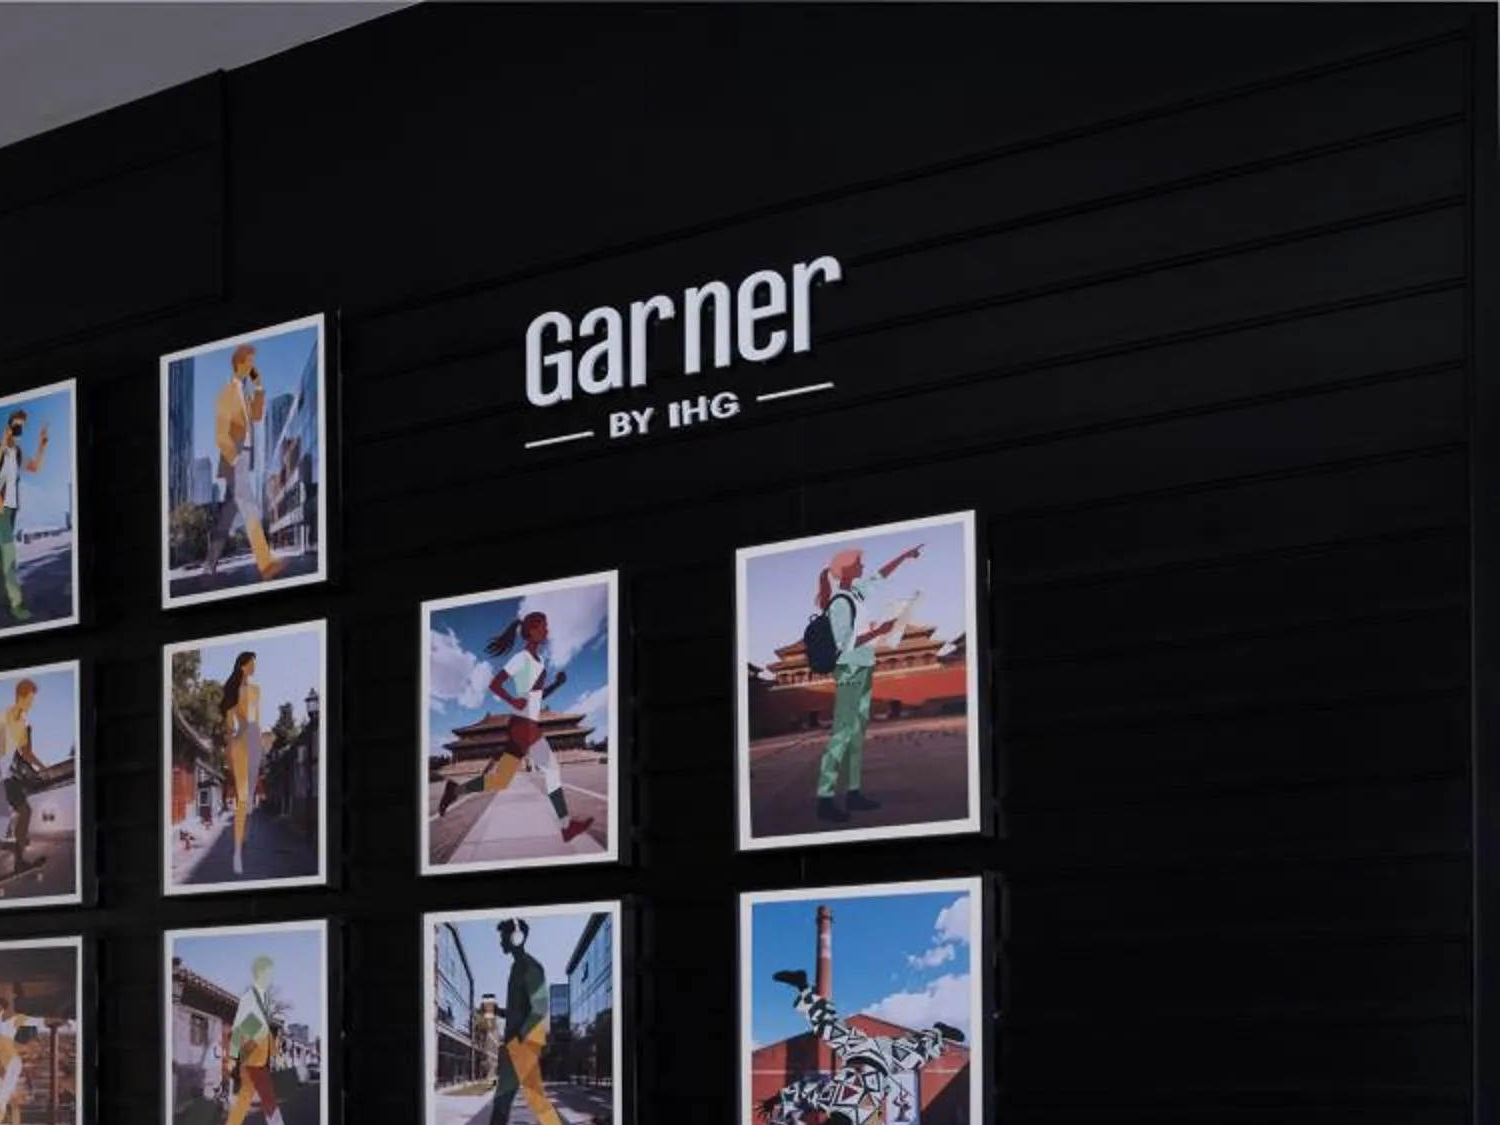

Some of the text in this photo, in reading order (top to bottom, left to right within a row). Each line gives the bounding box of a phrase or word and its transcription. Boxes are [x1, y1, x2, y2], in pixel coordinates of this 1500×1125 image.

[525, 255, 842, 407] Garner
[609, 391, 741, 439] BY IHG
